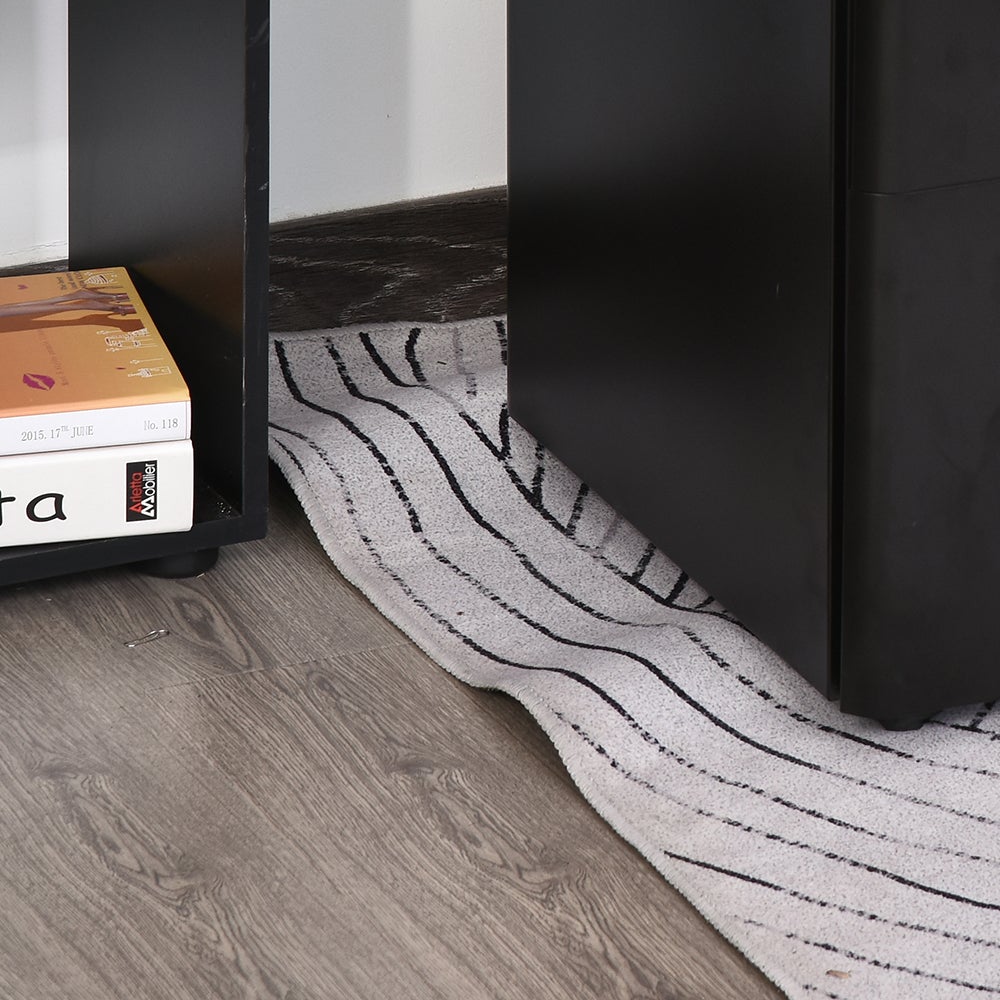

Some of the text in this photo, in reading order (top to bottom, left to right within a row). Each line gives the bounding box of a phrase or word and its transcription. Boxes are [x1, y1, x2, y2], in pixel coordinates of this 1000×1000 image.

[70, 425, 94, 439] JUNE
[130, 472, 143, 513] Arletta
[141, 463, 156, 518] Mobilier
